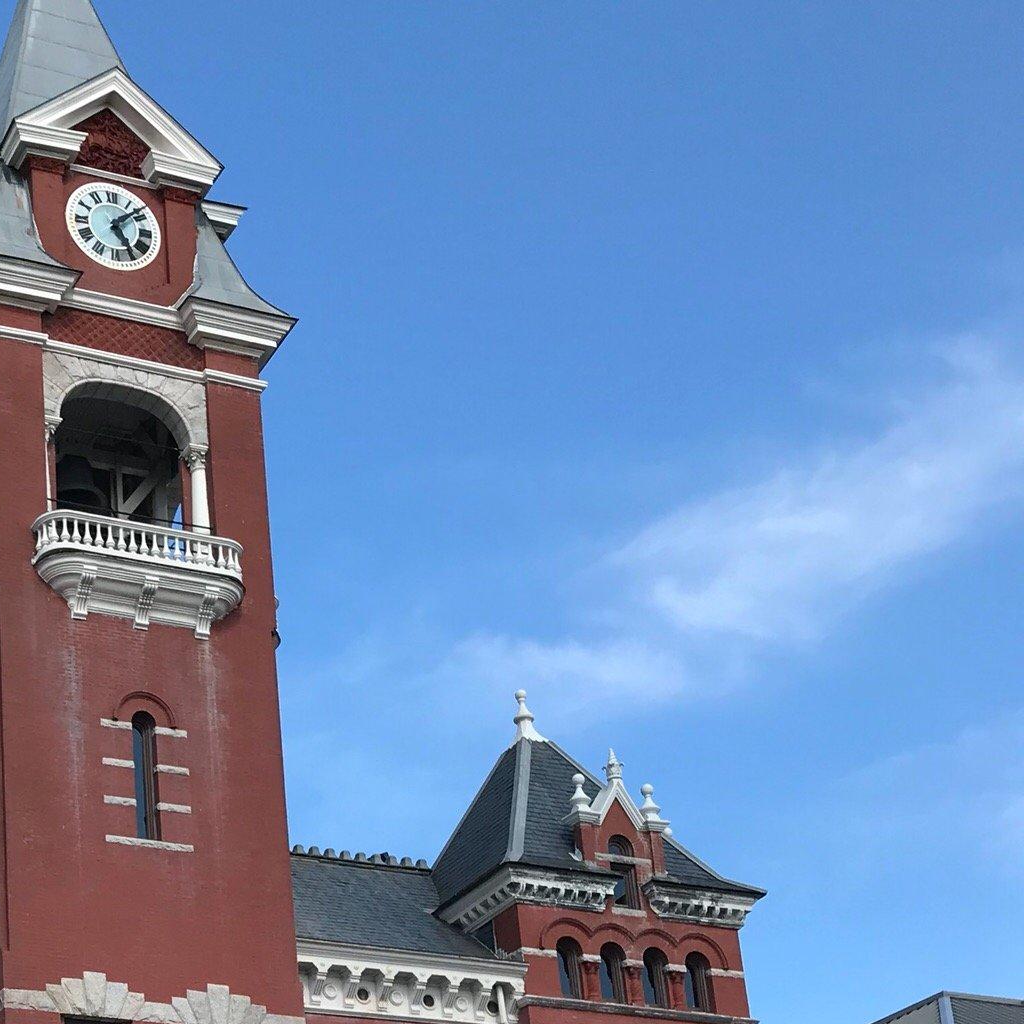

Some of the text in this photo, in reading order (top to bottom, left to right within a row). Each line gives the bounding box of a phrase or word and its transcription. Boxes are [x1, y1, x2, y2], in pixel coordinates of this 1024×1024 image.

[88, 191, 102, 204] XI
[105, 190, 117, 204] XII
[78, 200, 92, 211] X
[75, 213, 88, 224] IX
[133, 214, 147, 222] II
